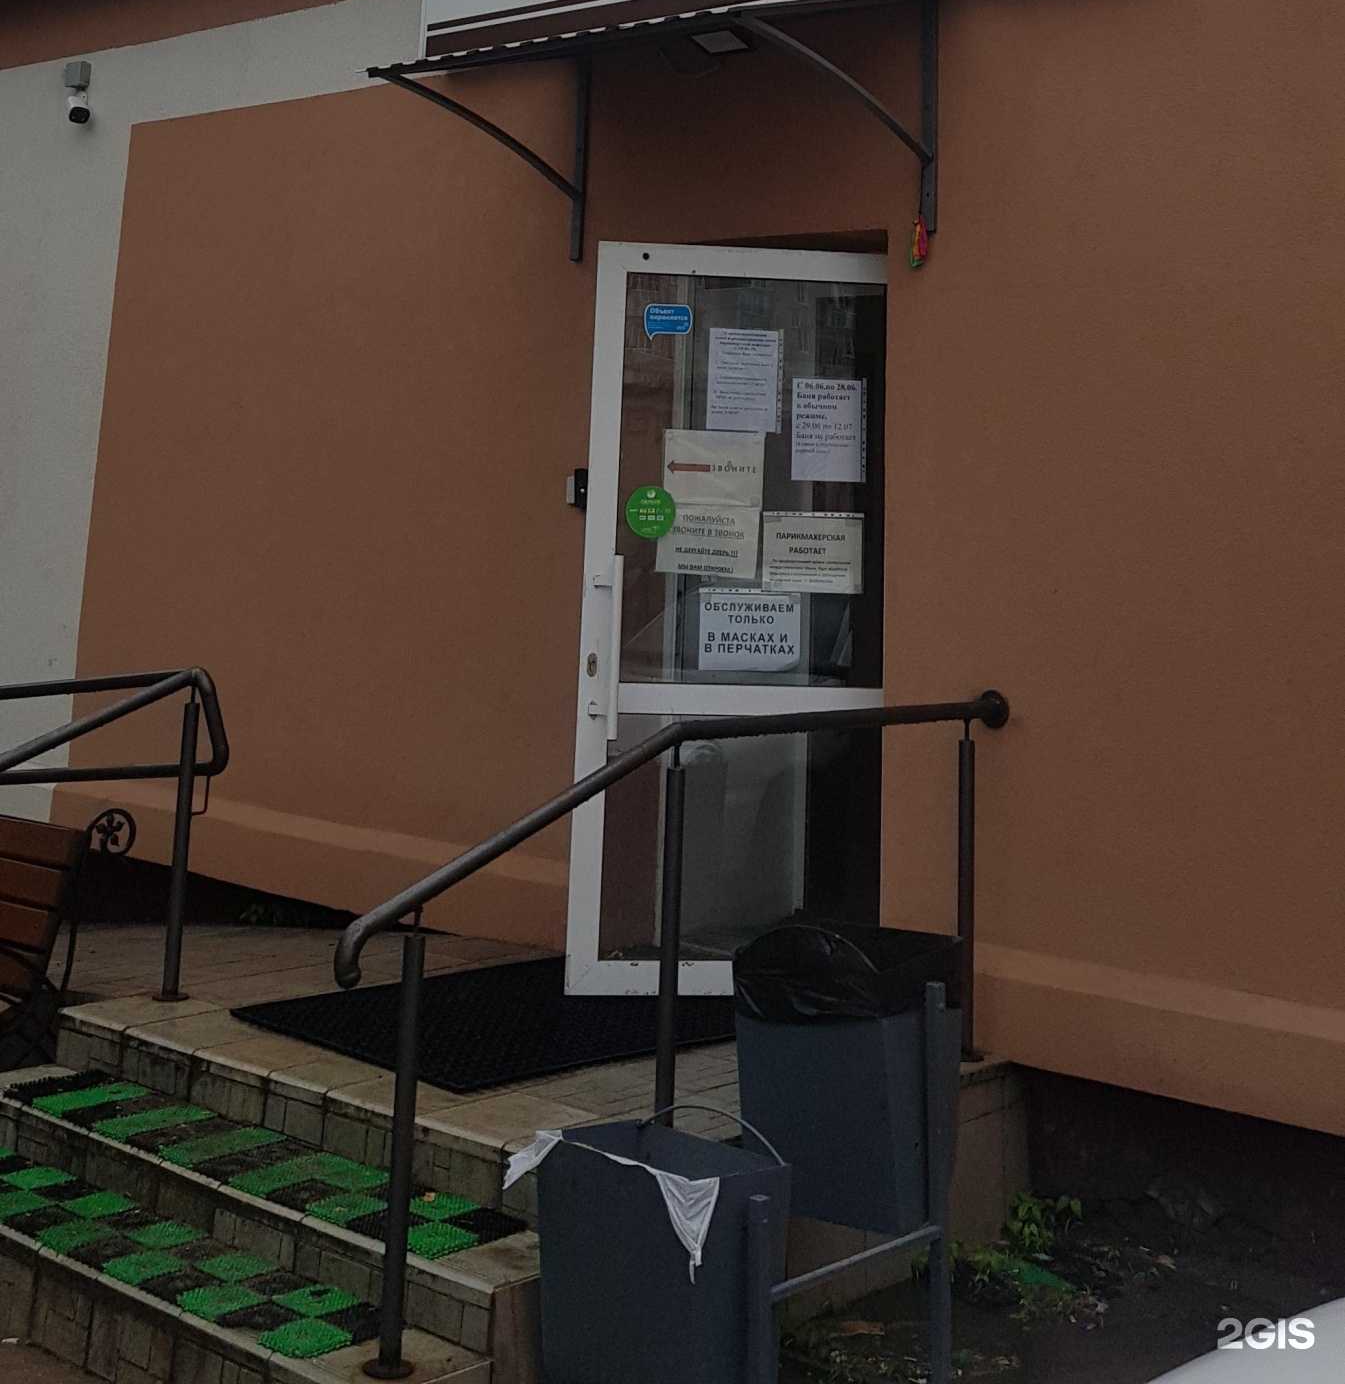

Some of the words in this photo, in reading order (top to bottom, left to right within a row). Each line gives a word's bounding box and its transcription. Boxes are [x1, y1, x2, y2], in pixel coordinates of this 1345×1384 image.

[683, 514, 736, 525] ПОЖАЛУЙСТА
[776, 532, 846, 542] ПАРИКМАХЕРСКАЯ
[789, 546, 826, 554] РАБОТАЕТ
[704, 602, 794, 613] ОБСЛУЖИВАЕМ
[728, 615, 774, 624] ТОЛЬКО
[707, 632, 715, 641] В
[721, 632, 774, 643] МАСКАХ
[780, 633, 788, 643] И
[704, 643, 712, 653] В
[718, 643, 795, 655] ПЕРЧАТКАХ
